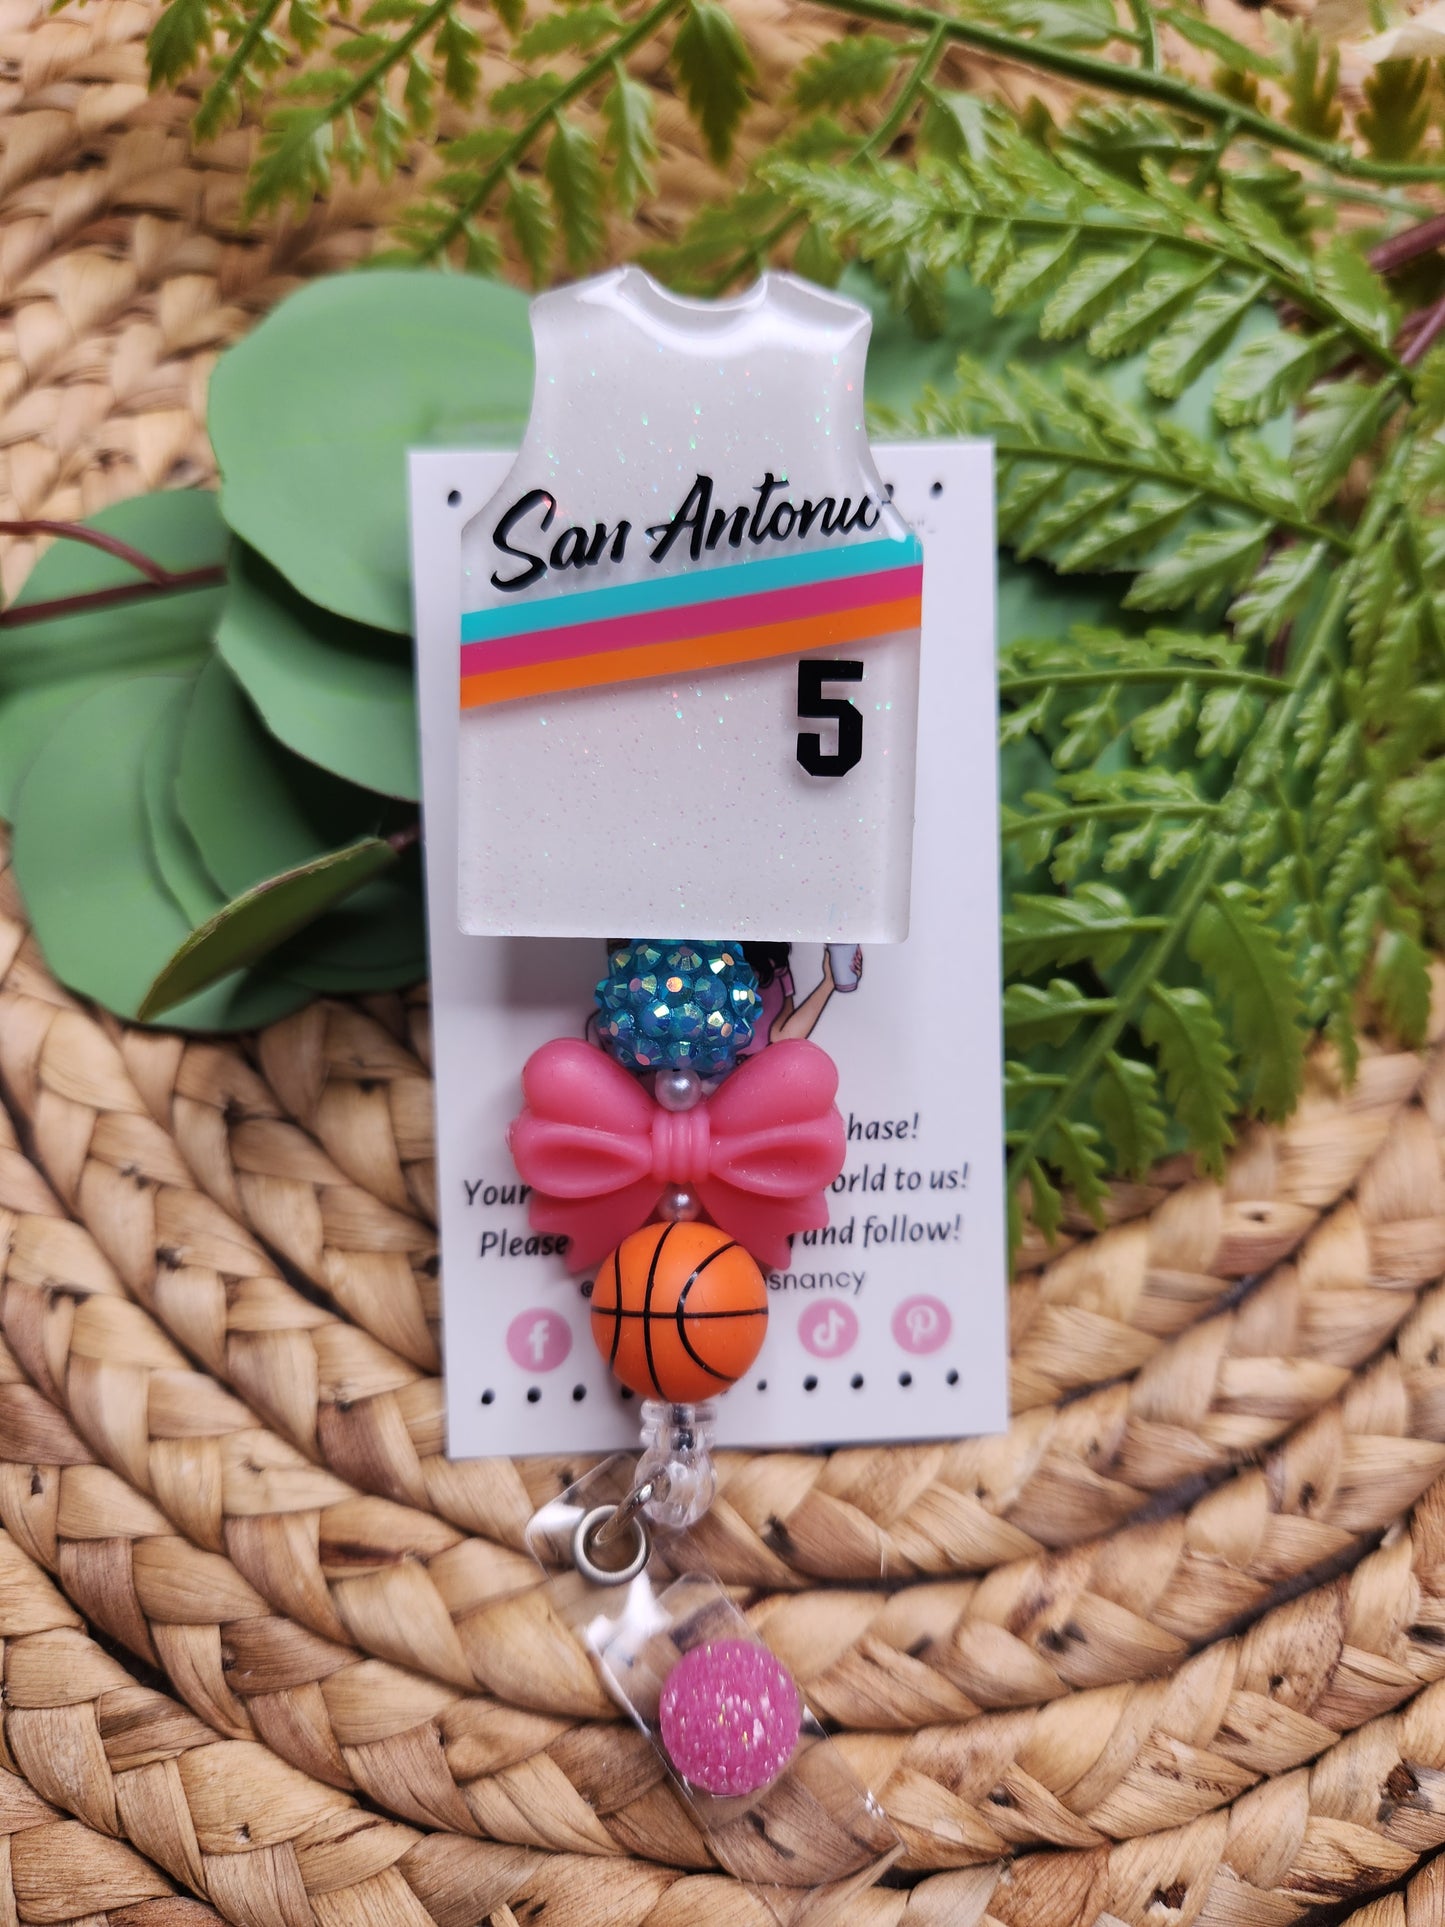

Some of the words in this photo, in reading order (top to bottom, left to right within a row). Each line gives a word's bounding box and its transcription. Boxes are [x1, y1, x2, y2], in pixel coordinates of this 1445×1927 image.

[490, 488, 631, 592] San
[796, 660, 864, 777] 5
[847, 1112, 919, 1140] hase!
[824, 1163, 886, 1193] orld
[895, 1167, 921, 1190] to
[930, 1162, 969, 1189] us!
[464, 1179, 532, 1206] Your
[480, 1229, 570, 1257] Please
[863, 1214, 961, 1248] follow!
[765, 1270, 866, 1294] snancy
